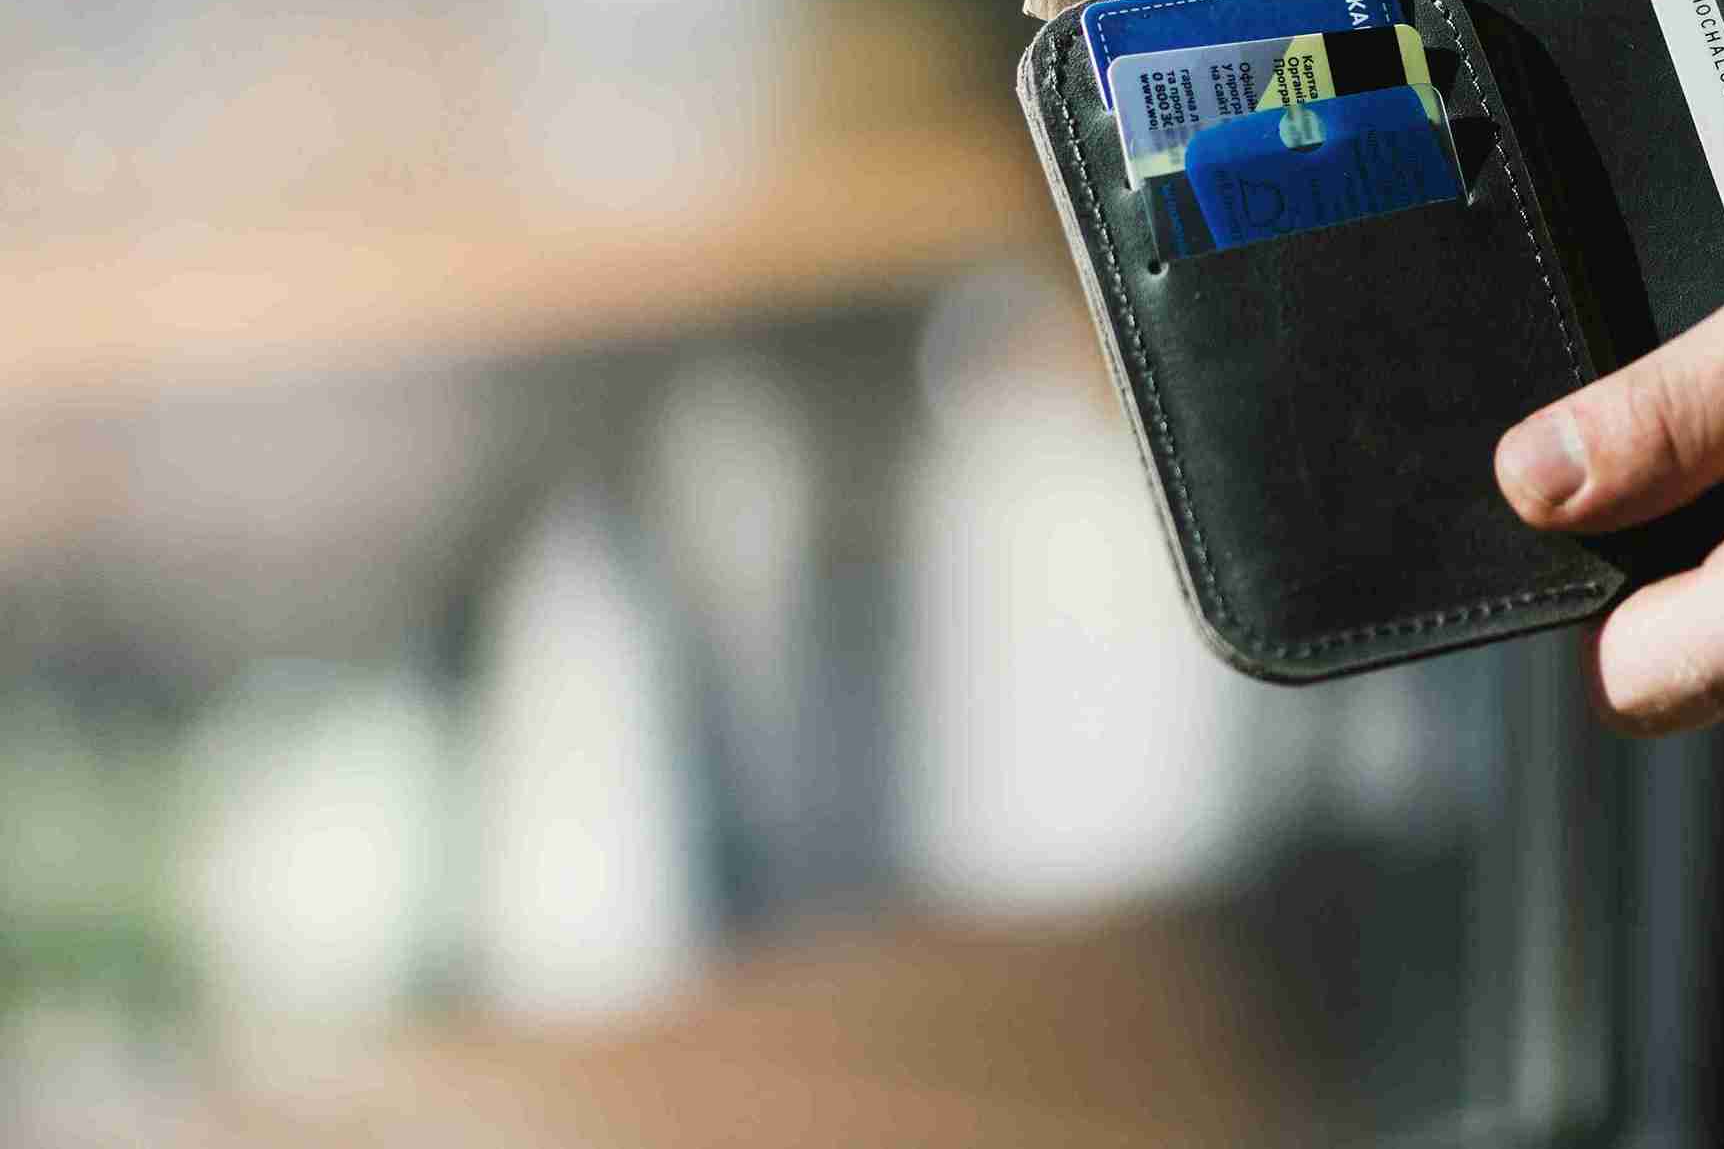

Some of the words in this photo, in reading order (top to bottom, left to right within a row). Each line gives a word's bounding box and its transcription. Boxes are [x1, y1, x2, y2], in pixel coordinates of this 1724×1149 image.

[1155, 83, 1170, 111] 800
[1273, 58, 1290, 107] Програ
[1302, 54, 1319, 100] Картка
